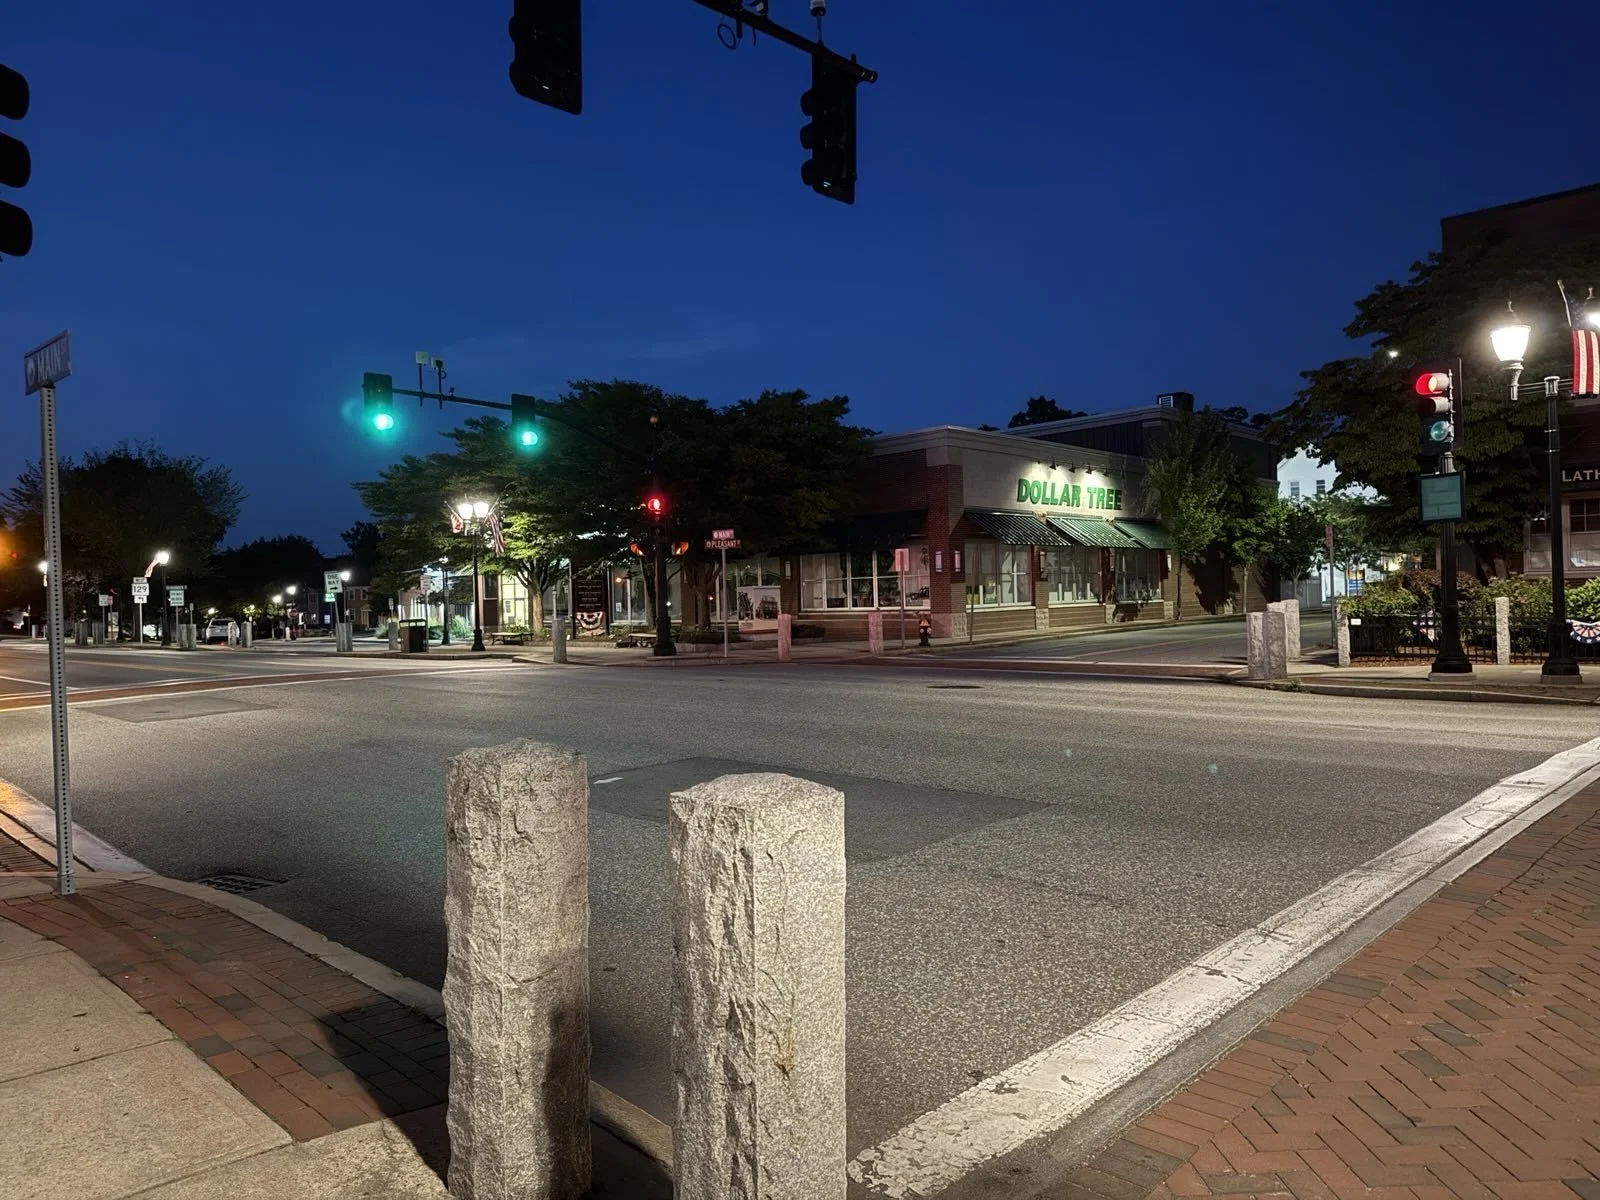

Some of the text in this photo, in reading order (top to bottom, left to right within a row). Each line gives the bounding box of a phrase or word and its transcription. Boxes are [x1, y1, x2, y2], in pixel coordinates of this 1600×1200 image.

[37, 339, 61, 384] MAIN
[1017, 478, 1123, 511] DOLLAR TREE
[711, 539, 737, 549] PLEASANT
[133, 585, 148, 593] 129
